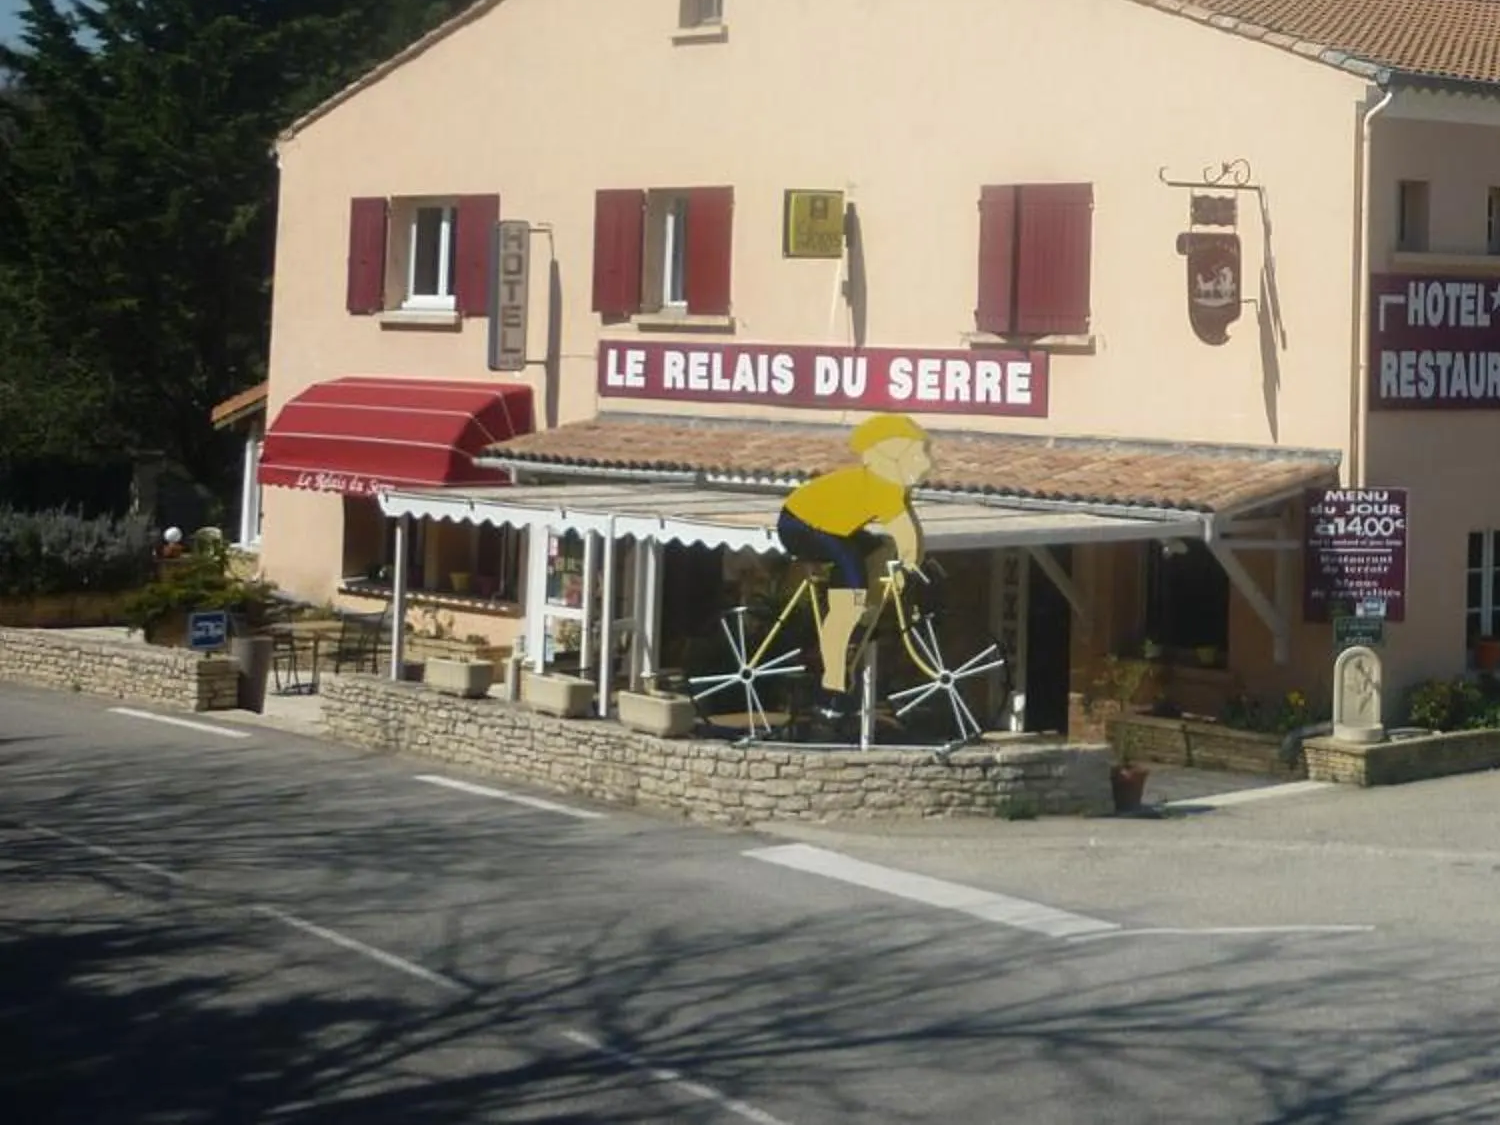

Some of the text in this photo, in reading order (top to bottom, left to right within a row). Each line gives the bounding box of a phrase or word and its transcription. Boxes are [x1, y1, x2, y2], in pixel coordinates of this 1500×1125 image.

[502, 227, 523, 354] HOTEL
[1407, 281, 1490, 327] HOTEL
[607, 349, 1032, 405] LE RELAIS DU SERRE
[1310, 503, 1401, 515] du JOUR
[1324, 490, 1389, 502] MENU
